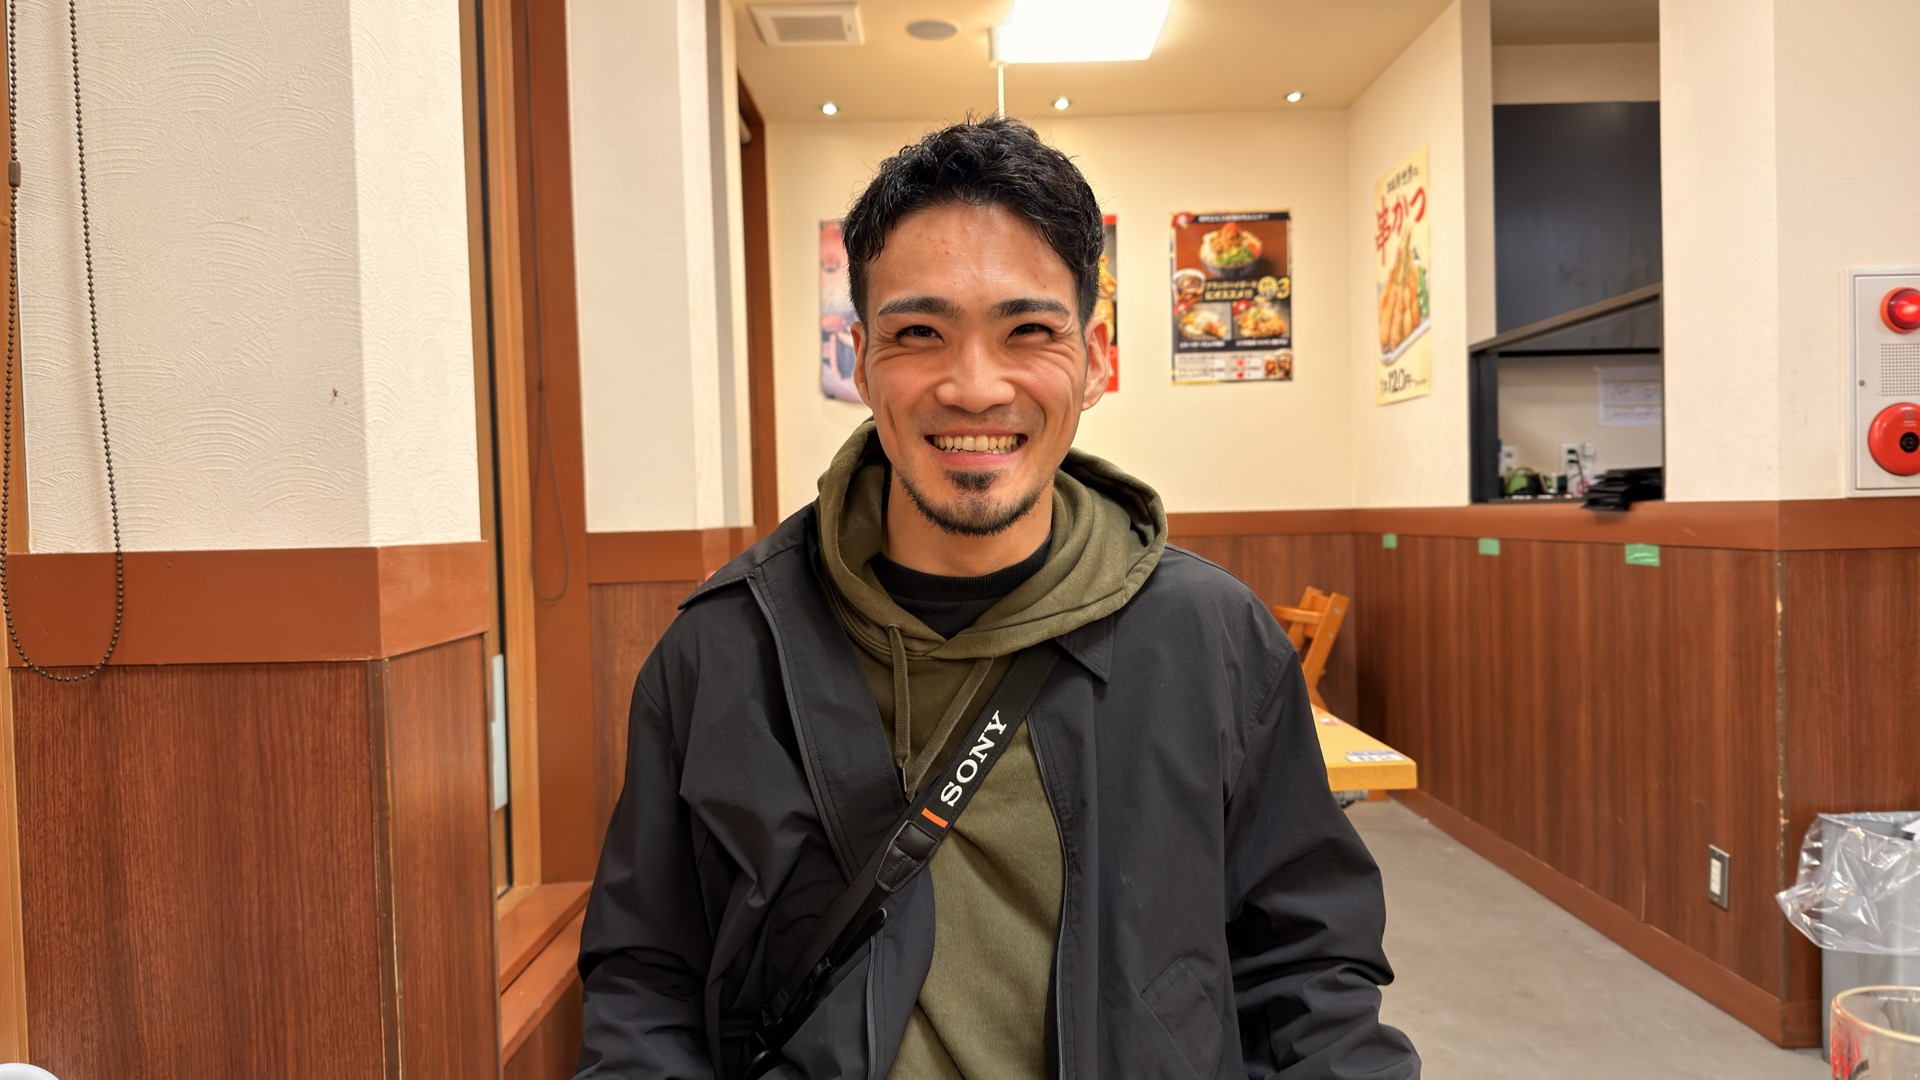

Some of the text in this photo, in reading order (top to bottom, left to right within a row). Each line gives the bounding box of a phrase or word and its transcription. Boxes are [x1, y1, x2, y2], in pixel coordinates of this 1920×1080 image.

[1375, 187, 1427, 267] 串かつ
[1276, 276, 1290, 300] 3
[940, 709, 1007, 808] SONY
